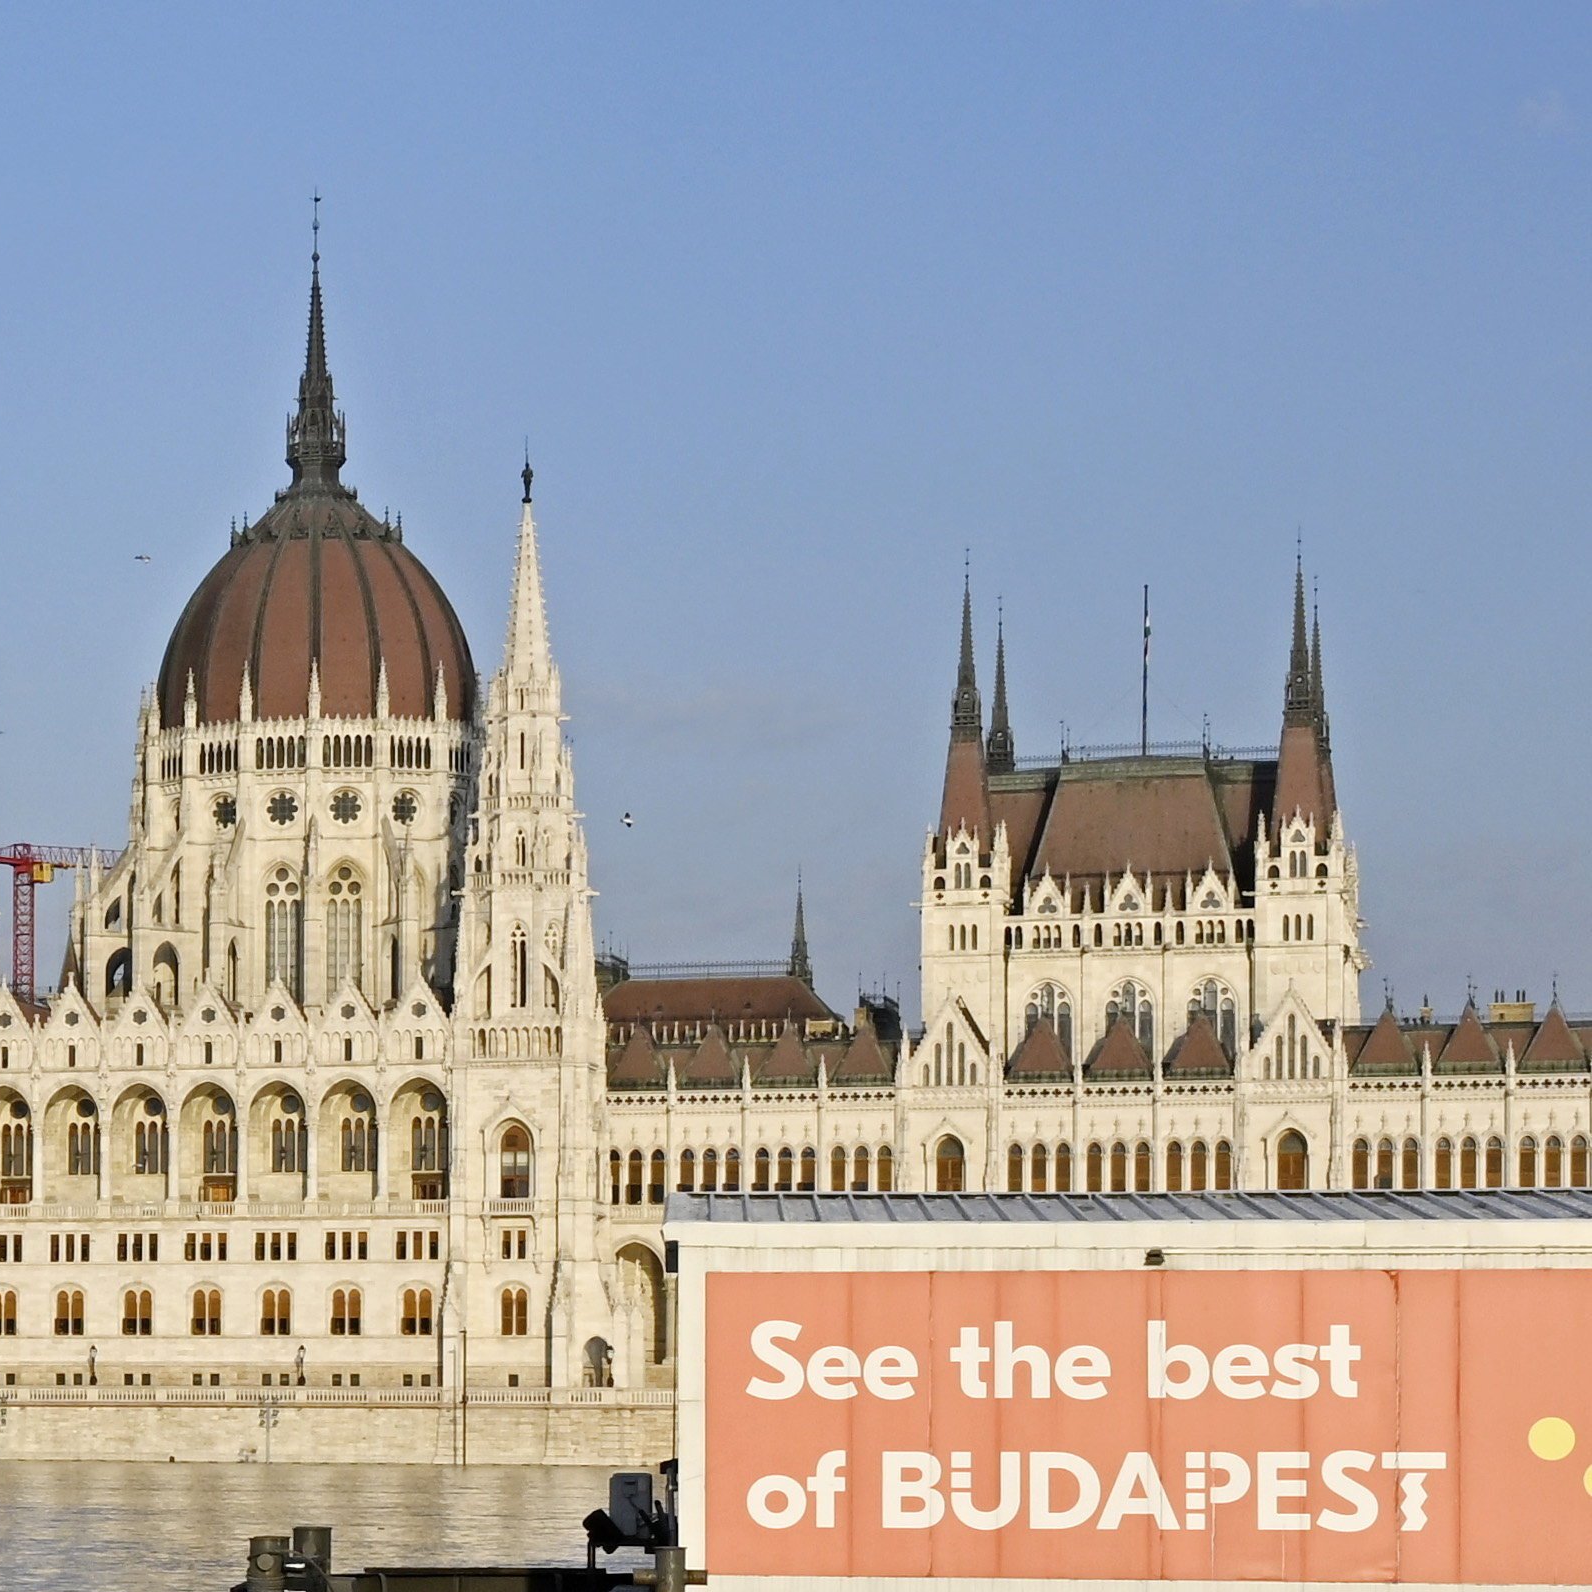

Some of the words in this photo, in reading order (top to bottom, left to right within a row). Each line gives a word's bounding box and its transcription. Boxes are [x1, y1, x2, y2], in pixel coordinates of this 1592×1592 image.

[745, 1320, 918, 1400] See
[950, 1320, 1110, 1399] the
[1148, 1320, 1362, 1399] best
[746, 1449, 846, 1529] of
[882, 1450, 1447, 1532] BUDAPEST
